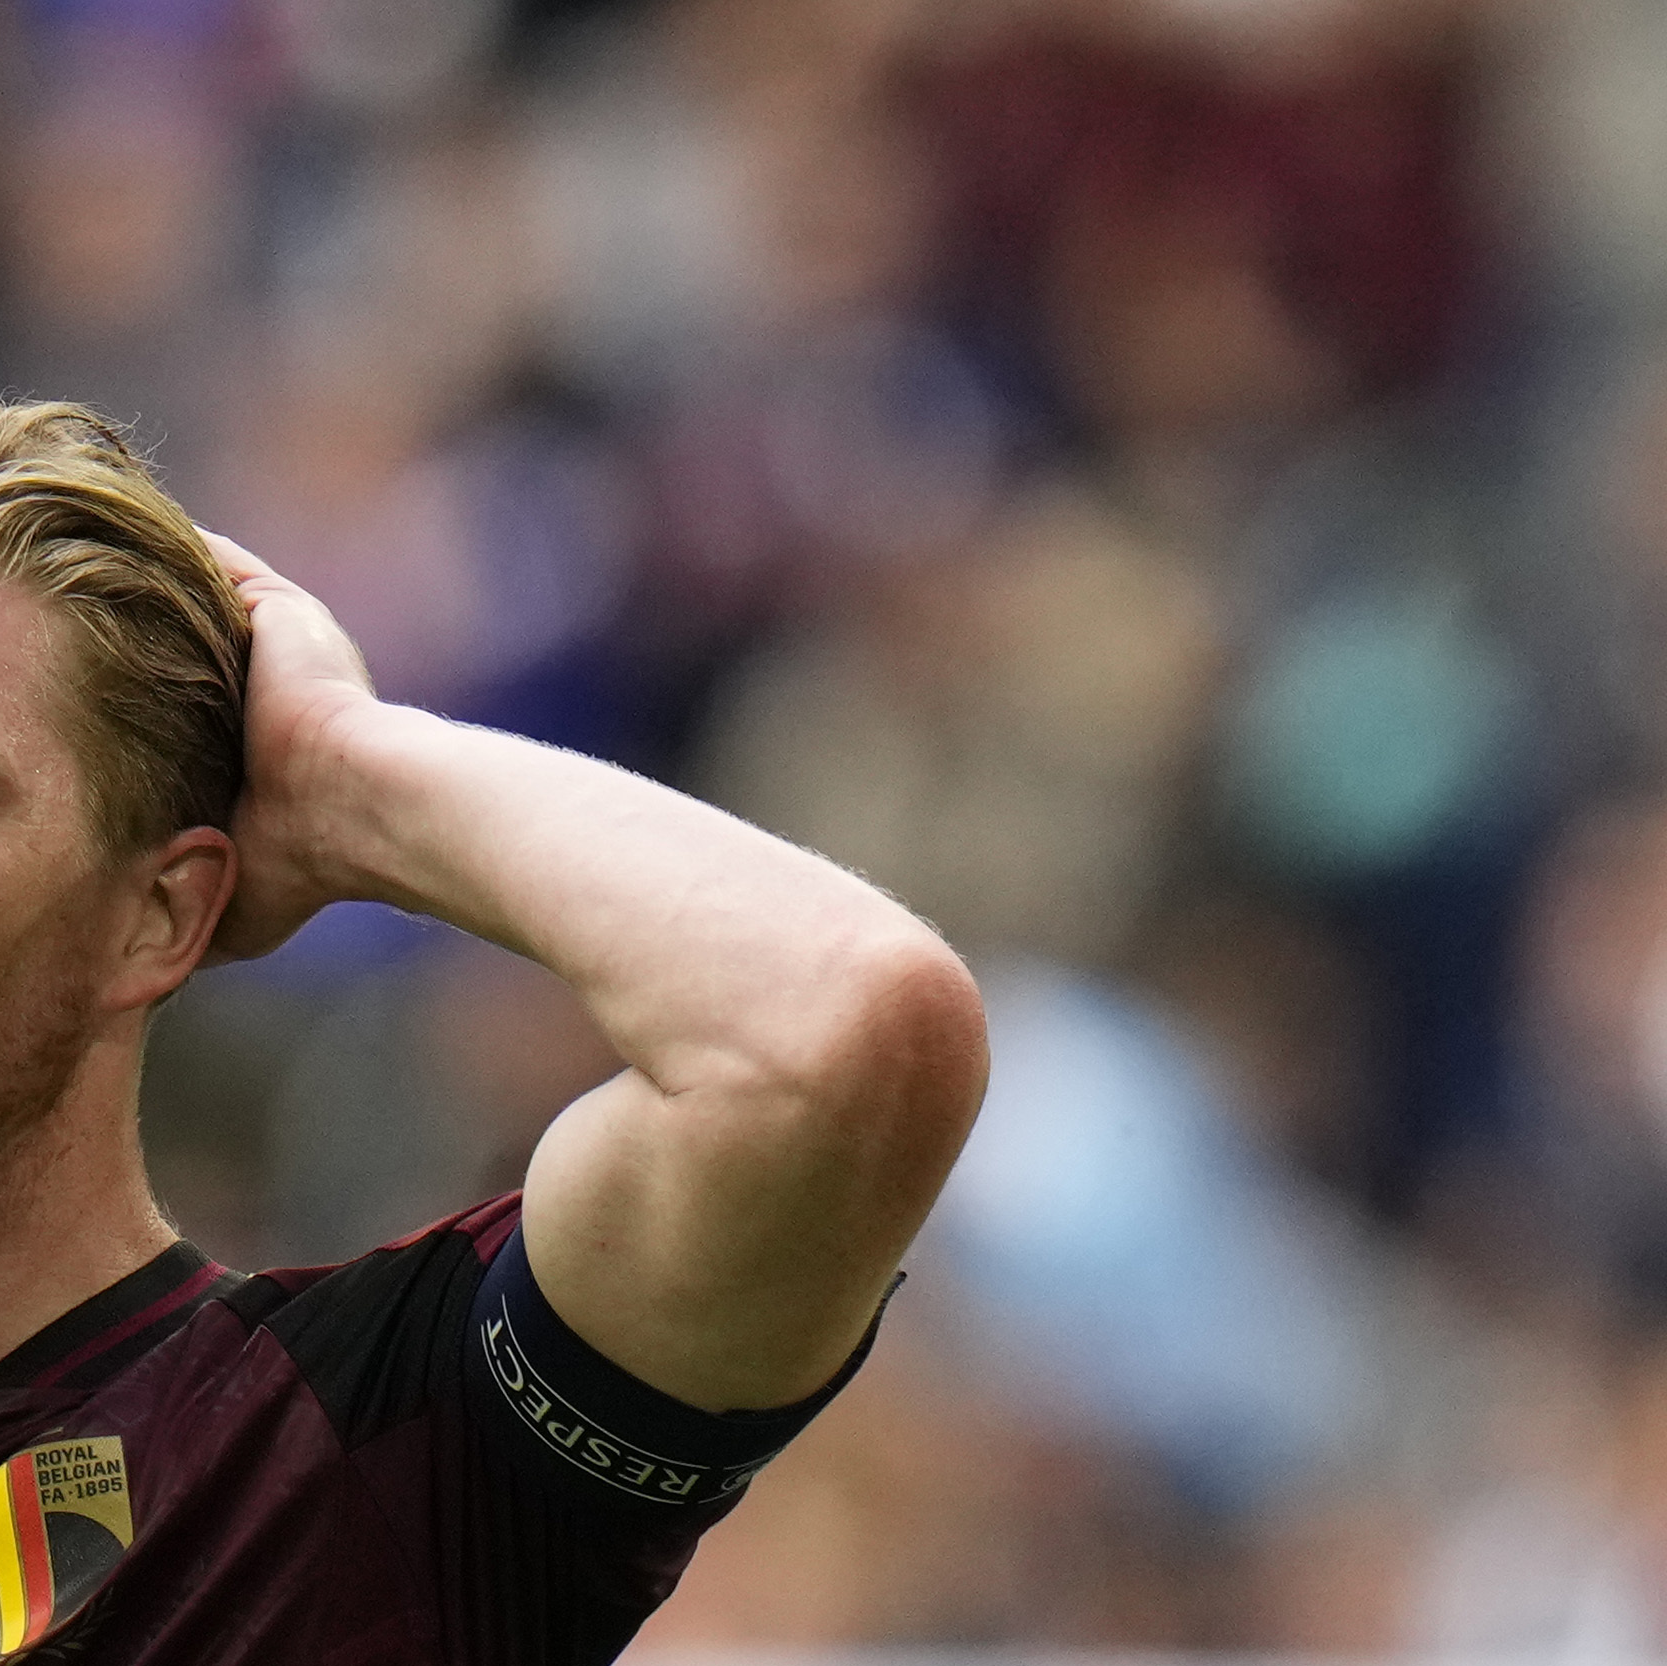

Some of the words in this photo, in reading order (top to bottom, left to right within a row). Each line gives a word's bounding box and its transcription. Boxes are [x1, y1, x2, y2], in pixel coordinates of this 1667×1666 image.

[486, 1318, 700, 1496] RESPECT
[36, 1444, 98, 1467] ROYAL
[38, 1459, 121, 1486] BELGIAN
